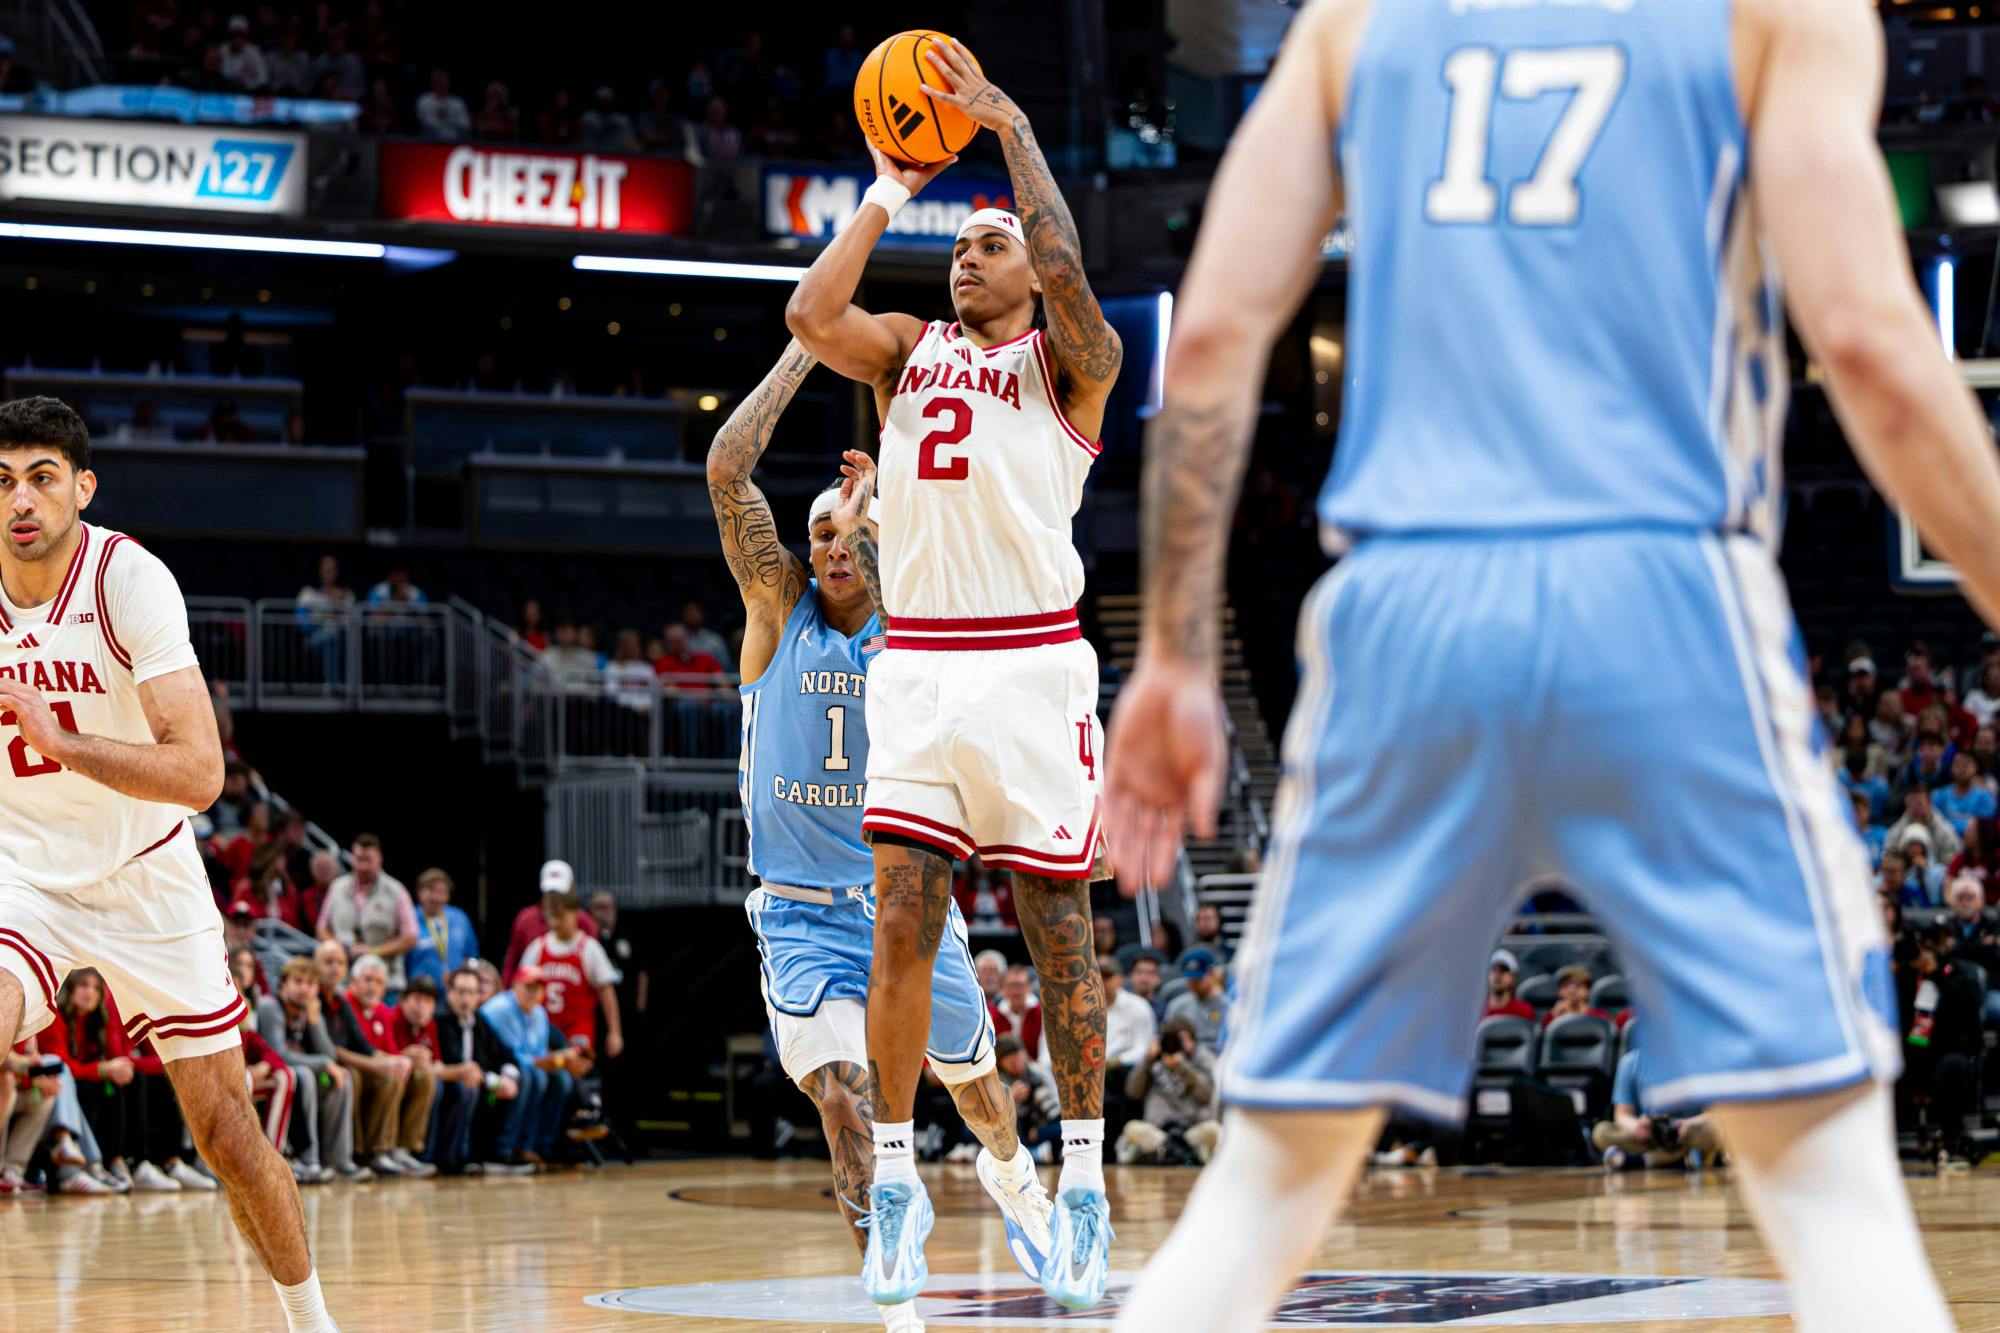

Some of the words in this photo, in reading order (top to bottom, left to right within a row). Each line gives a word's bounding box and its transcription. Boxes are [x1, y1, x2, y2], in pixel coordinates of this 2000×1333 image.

[863, 98, 879, 136] PRO
[1424, 45, 1627, 226] 17
[0, 138, 195, 183] SECTION
[206, 150, 277, 196] 127
[918, 397, 973, 480] 2
[824, 705, 850, 771] 1
[545, 983, 565, 1013] 5
